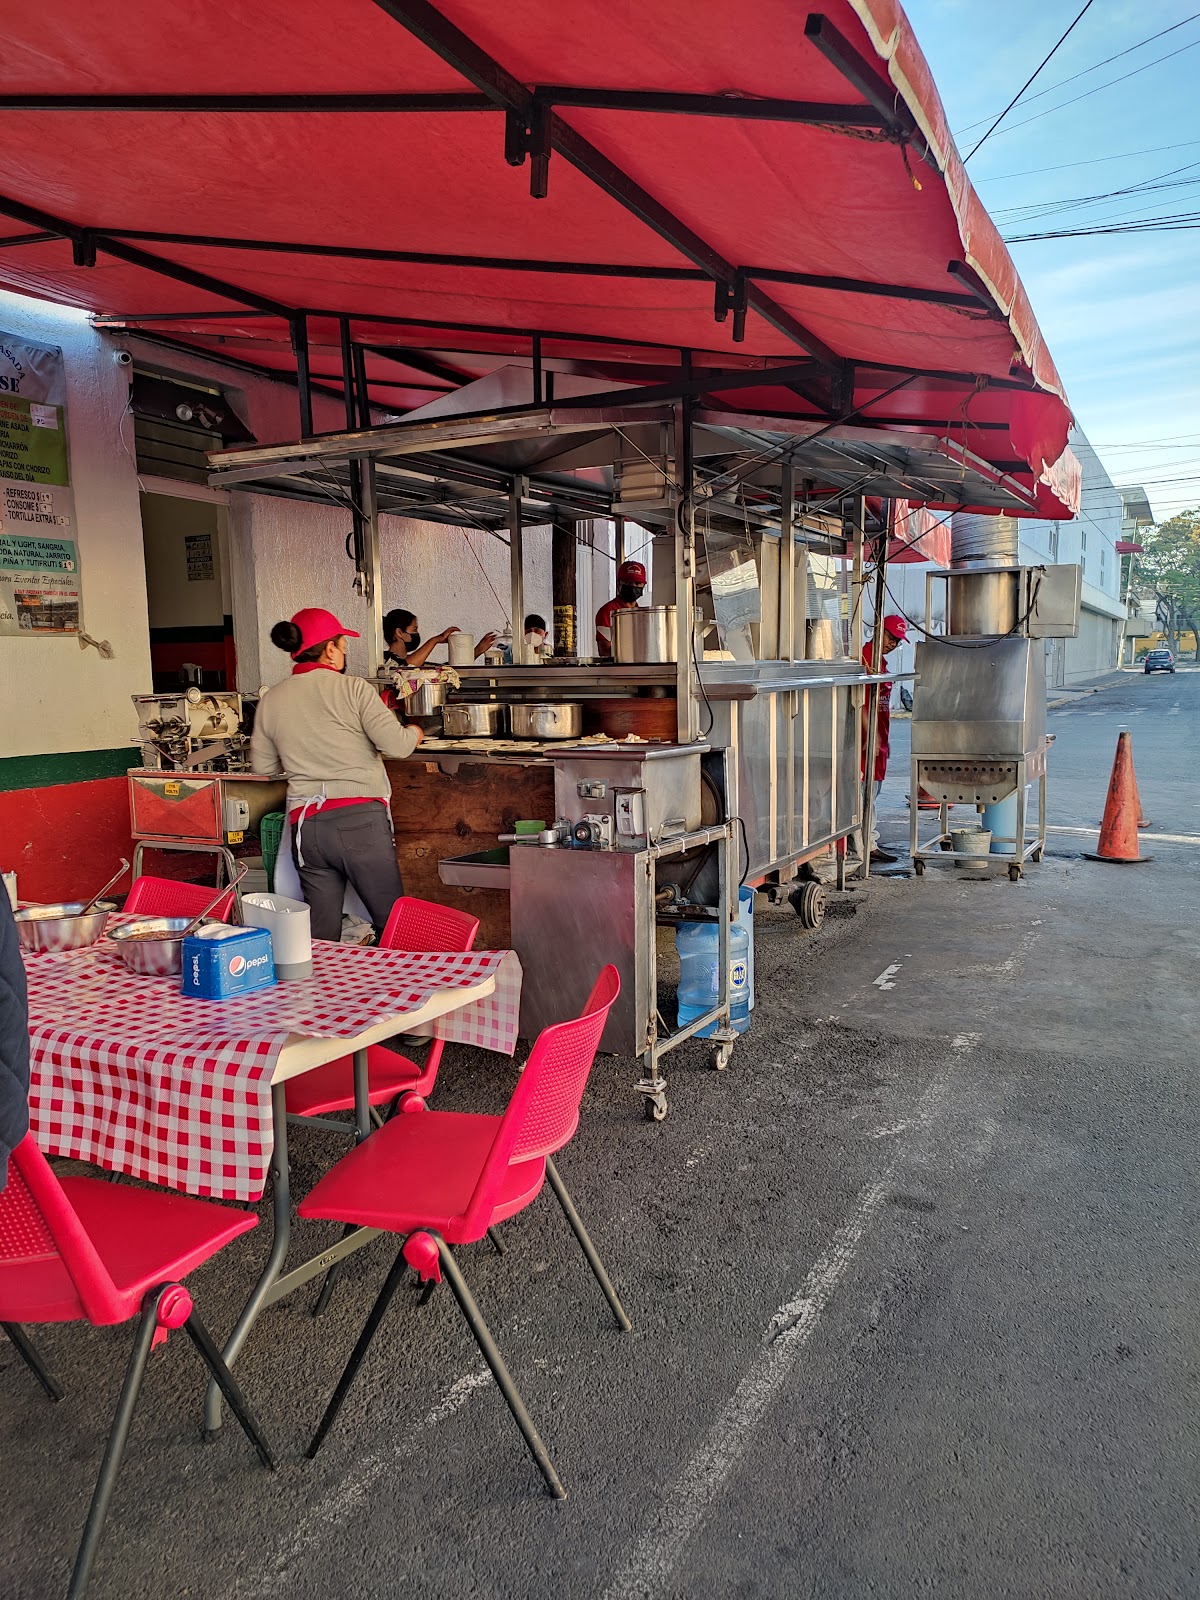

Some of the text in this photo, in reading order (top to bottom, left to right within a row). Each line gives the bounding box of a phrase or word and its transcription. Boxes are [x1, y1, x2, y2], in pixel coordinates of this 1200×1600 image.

[10, 422, 30, 432] ASADA
[14, 462, 24, 470] CON
[26, 464, 50, 474] CHORIZO
[14, 472, 25, 480] DEL
[36, 514, 52, 524] EXTRA
[3, 557, 18, 565] PIÑA
[26, 559, 57, 568] TUTIFRUTI
[14, 574, 40, 584] Eventos
[246, 954, 268, 970] pepsi
[192, 954, 200, 986] pepsi
